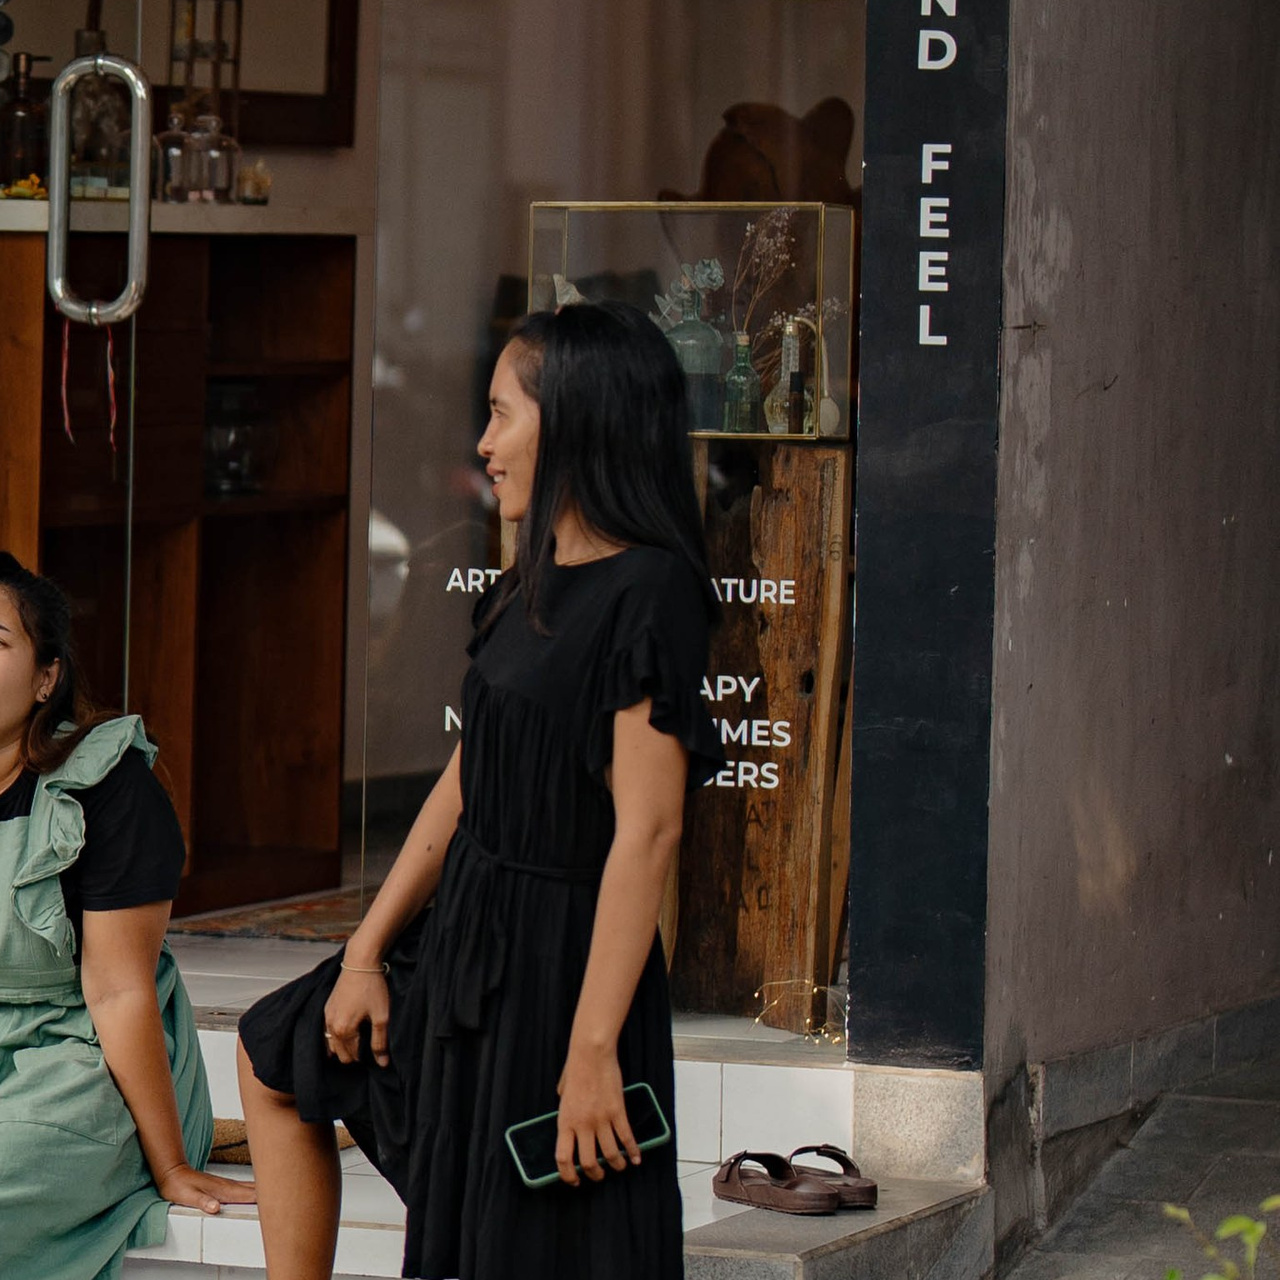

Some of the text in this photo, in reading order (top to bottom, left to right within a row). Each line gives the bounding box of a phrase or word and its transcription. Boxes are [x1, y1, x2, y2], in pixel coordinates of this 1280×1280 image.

[918, 143, 952, 346] FEEL
[711, 718, 792, 747] MES
[702, 760, 780, 790] ERS
